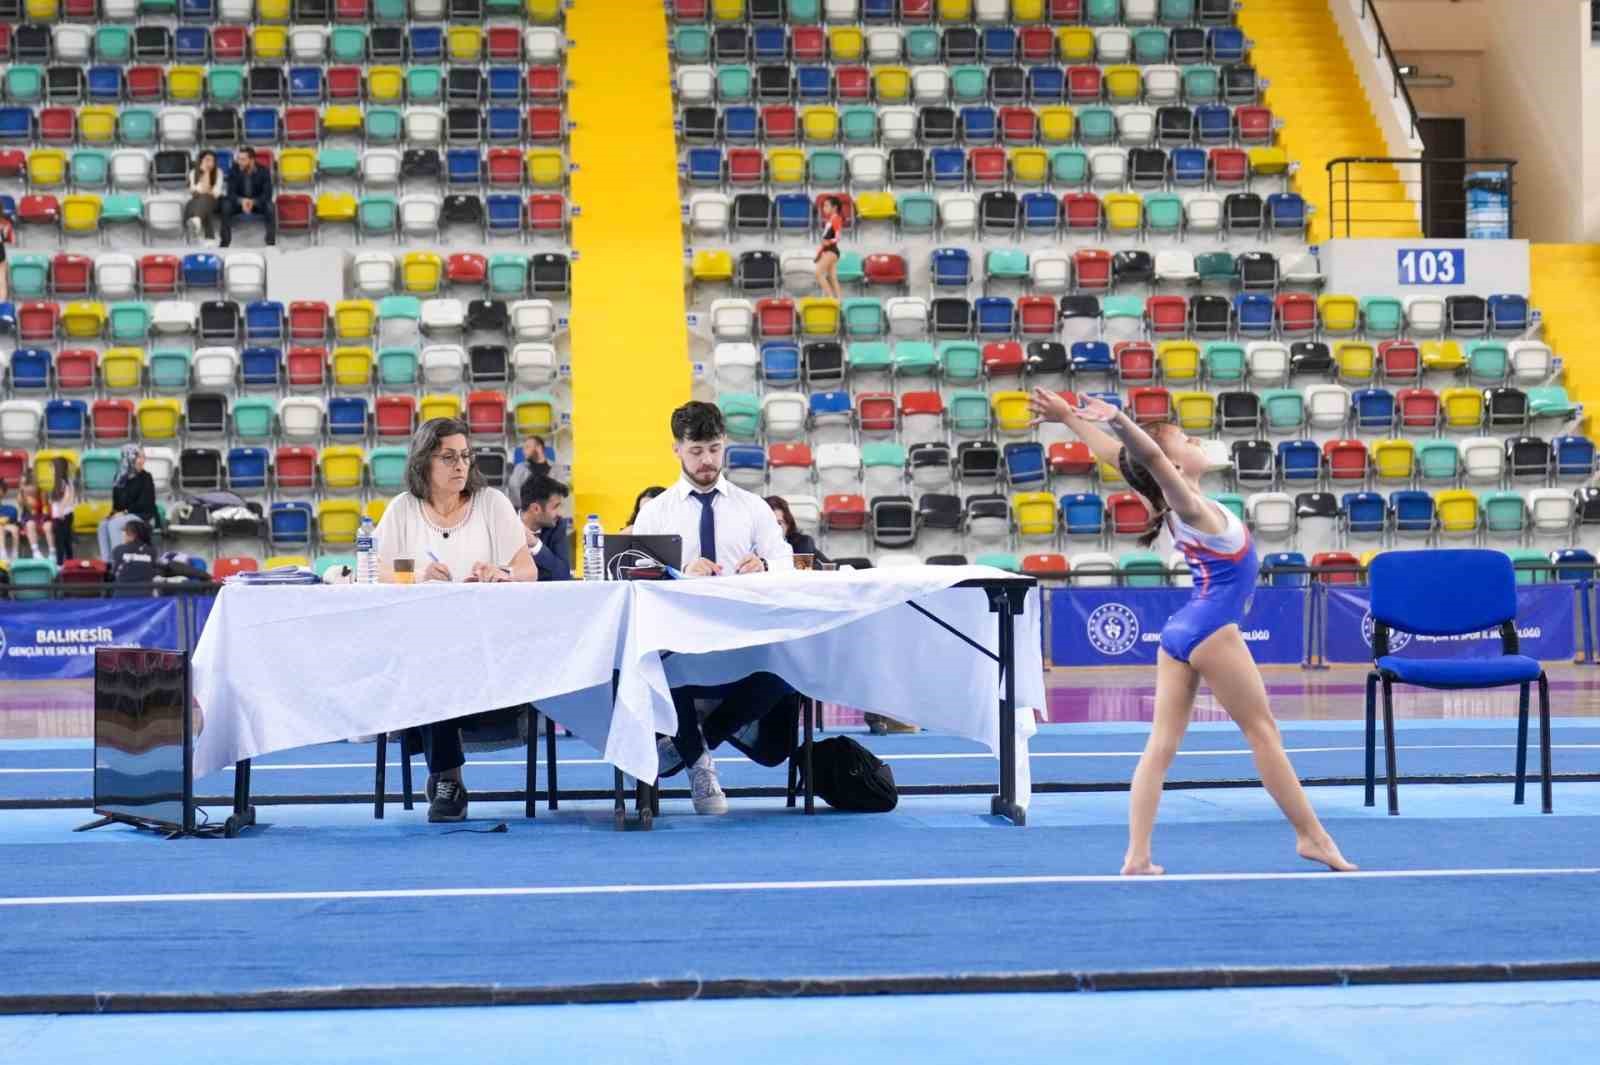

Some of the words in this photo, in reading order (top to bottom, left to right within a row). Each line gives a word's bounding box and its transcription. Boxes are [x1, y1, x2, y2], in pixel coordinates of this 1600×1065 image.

[1401, 251, 1456, 283] 103
[36, 626, 113, 643] BALIKESİR
[44, 646, 55, 656] VE
[55, 646, 78, 656] SPOR
